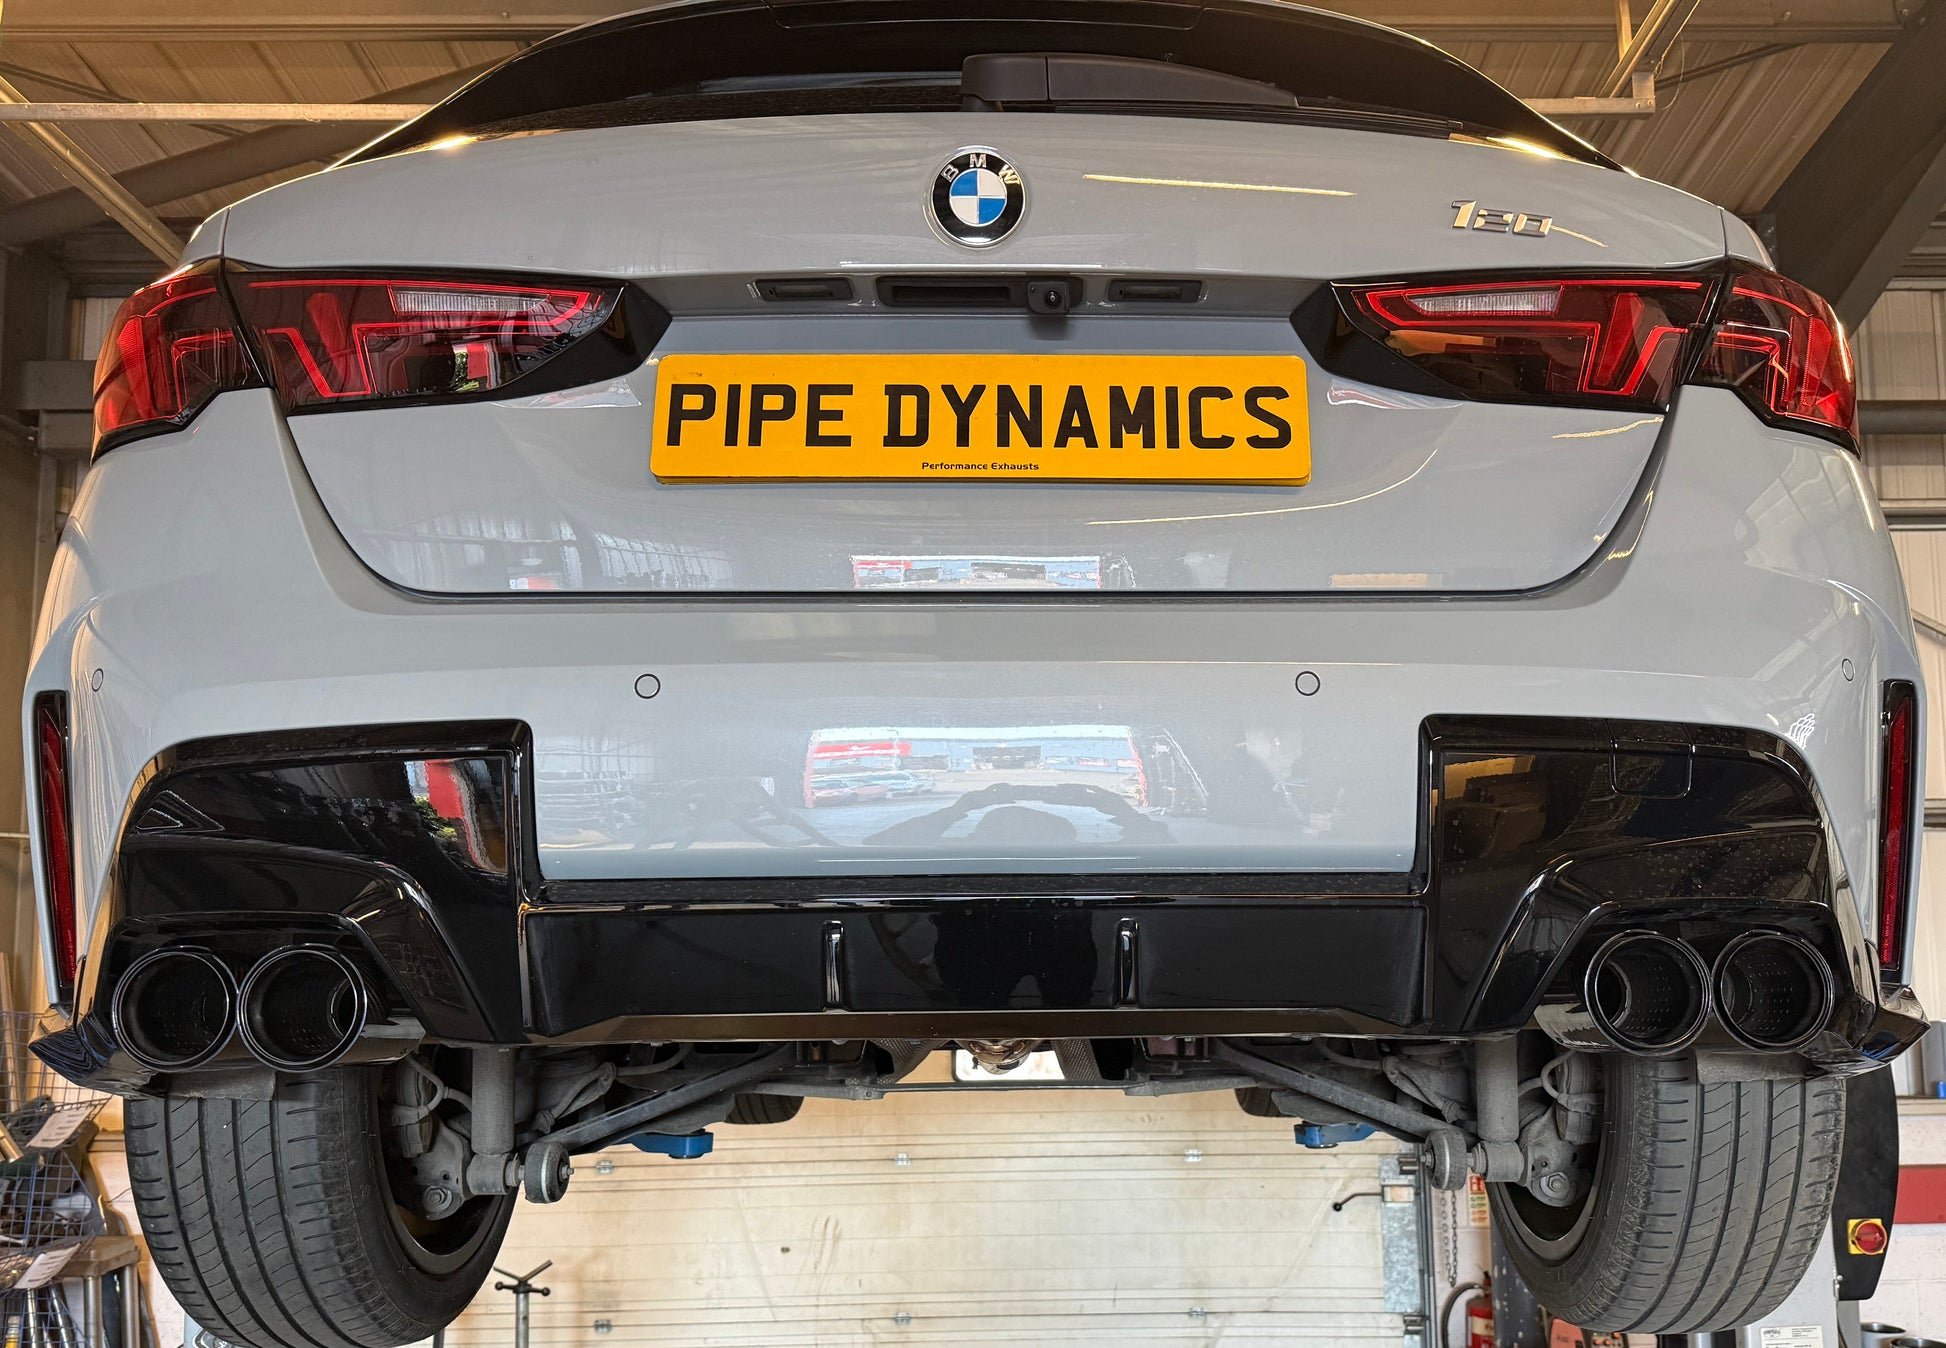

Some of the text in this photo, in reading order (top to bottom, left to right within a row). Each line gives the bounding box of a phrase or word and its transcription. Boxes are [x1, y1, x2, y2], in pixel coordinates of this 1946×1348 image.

[940, 153, 1020, 185] BMW
[1451, 199, 1554, 237] 120
[666, 383, 1292, 450] PIPE DYNAMICS
[921, 461, 1040, 471] Performance Exhausts
